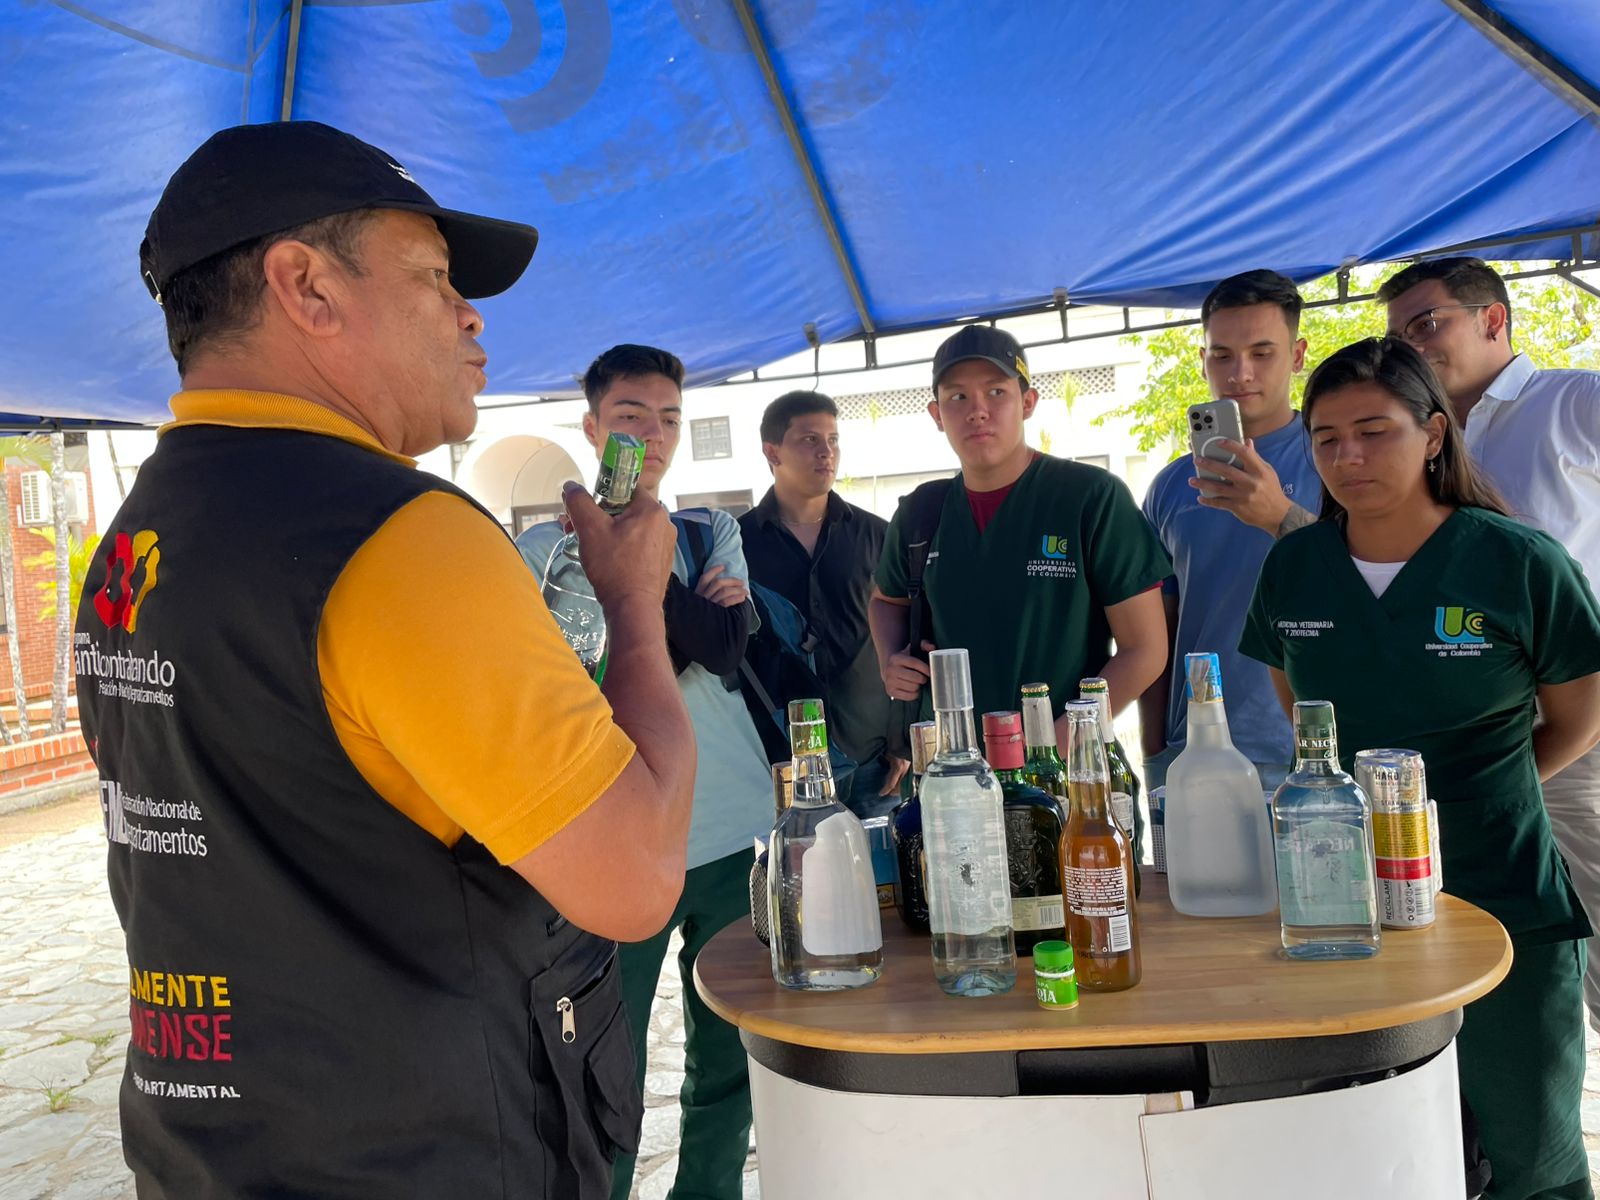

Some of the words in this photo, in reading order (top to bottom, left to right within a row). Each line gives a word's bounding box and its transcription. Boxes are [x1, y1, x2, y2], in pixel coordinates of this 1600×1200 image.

[1027, 565, 1076, 573] COOPERATIVA
[145, 797, 188, 820] Nacional
[188, 801, 203, 821] de
